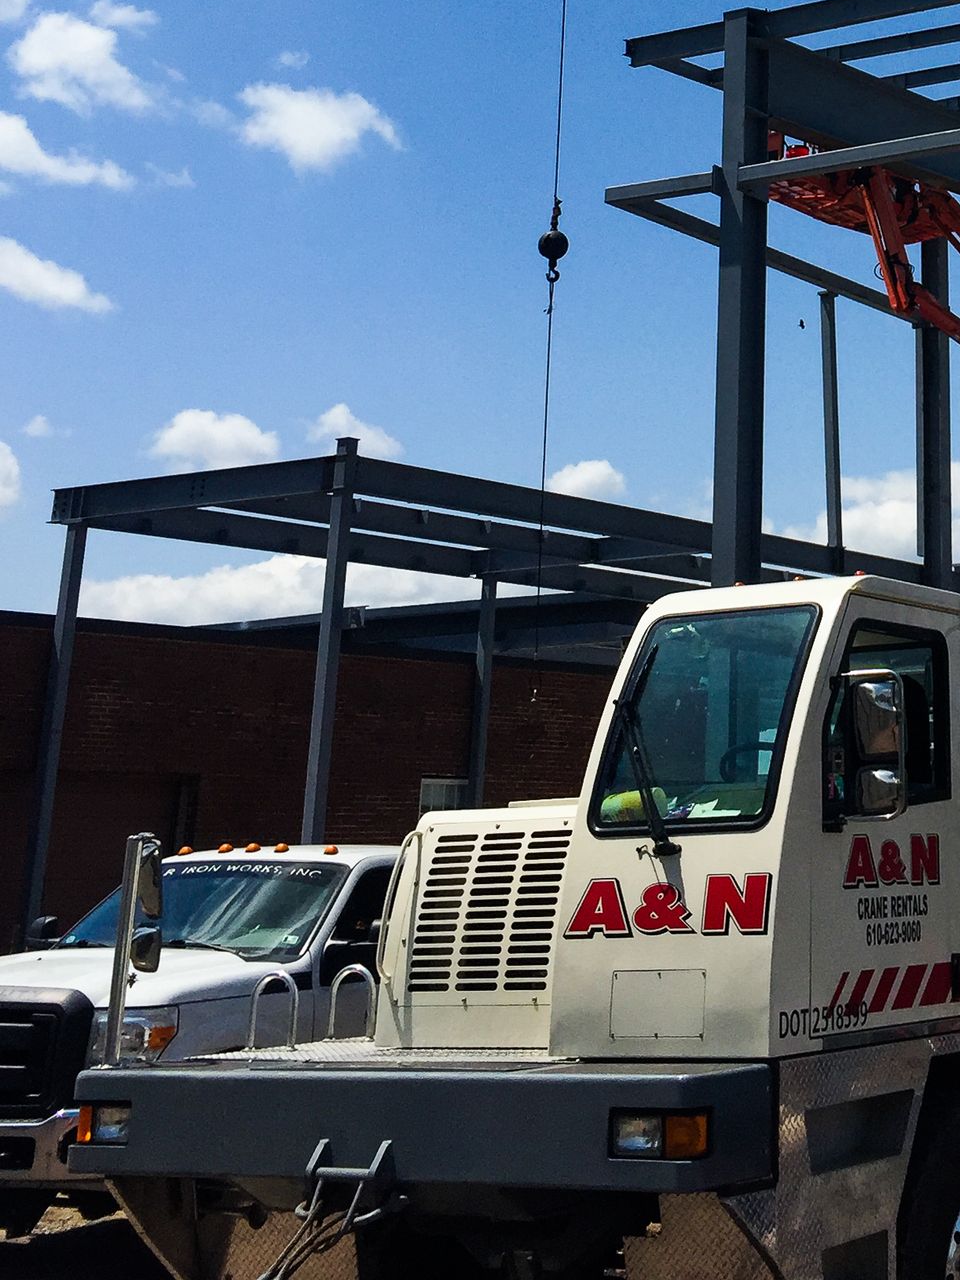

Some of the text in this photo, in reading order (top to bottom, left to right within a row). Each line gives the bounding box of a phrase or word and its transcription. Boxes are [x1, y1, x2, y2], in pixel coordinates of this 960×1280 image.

[181, 864, 221, 875] IRON
[226, 864, 283, 875] WORKS,
[290, 868, 322, 878] INC
[843, 833, 940, 889] A&N
[563, 872, 773, 939] A&N
[857, 894, 928, 920] CRANE RENTALS
[866, 920, 921, 946] 610-623-9060
